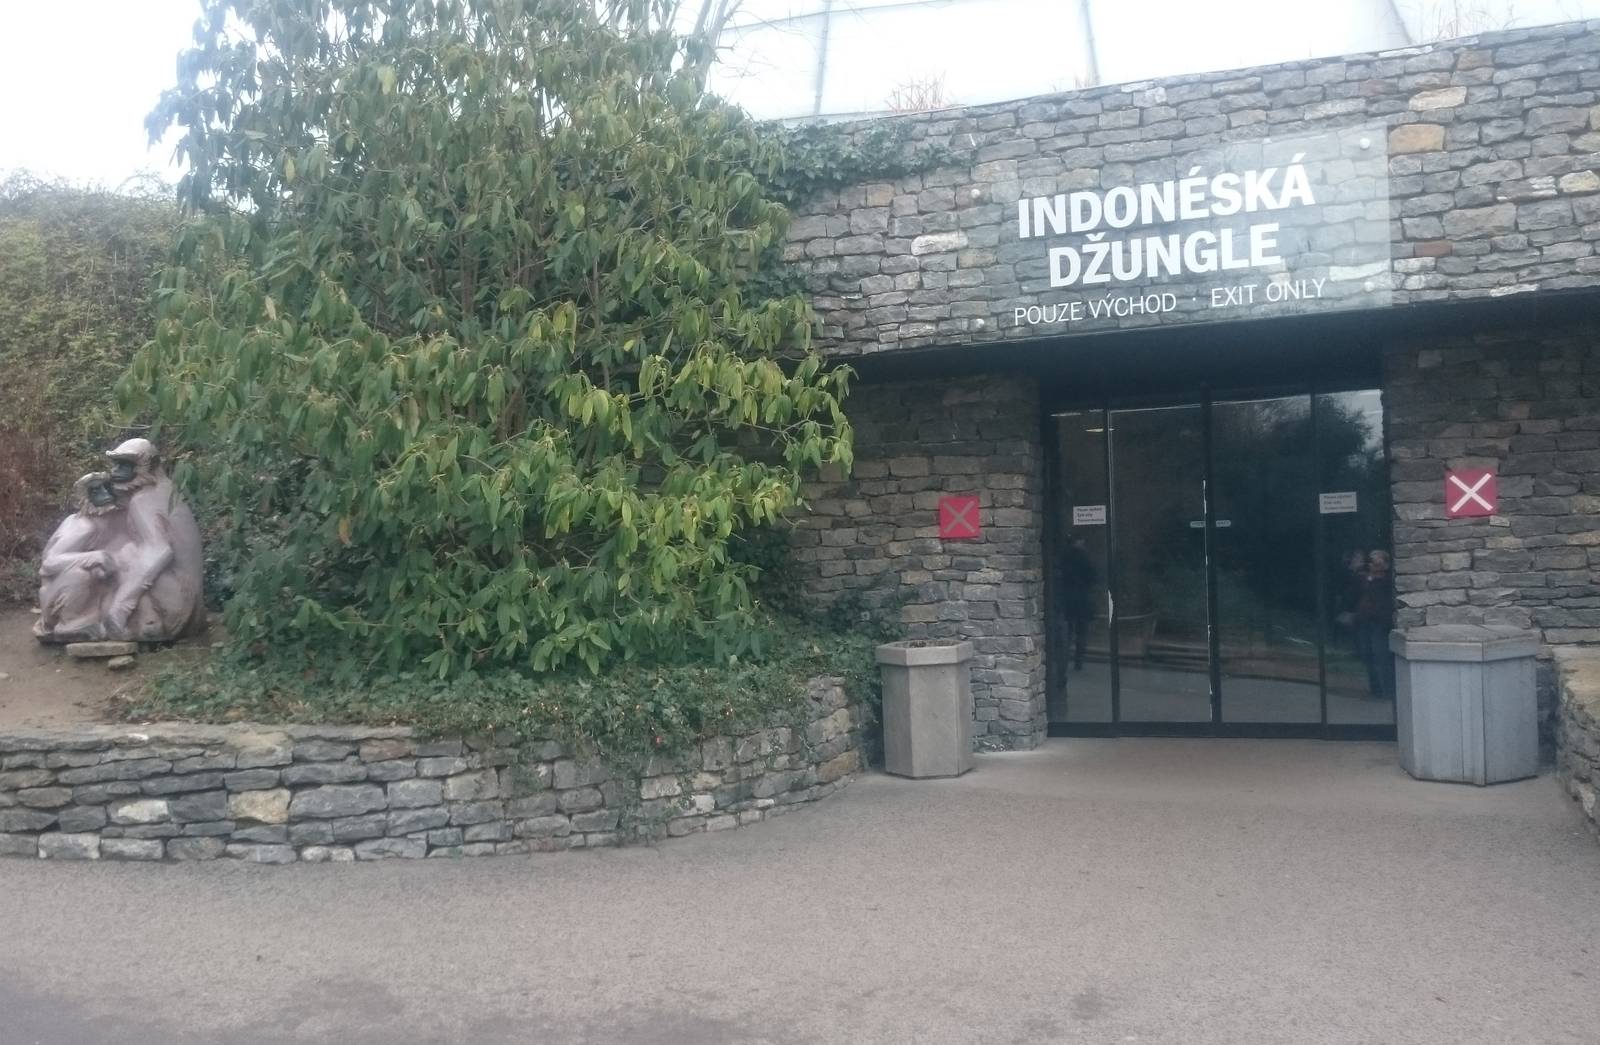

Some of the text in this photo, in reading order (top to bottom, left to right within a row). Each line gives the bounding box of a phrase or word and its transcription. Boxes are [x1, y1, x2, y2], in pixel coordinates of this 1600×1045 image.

[1018, 152, 1316, 239] INDONÉSKÁ
[1049, 222, 1282, 288] DŽUNGLE
[1014, 277, 1328, 326] POUZE VÝCHOD EXIT ONLY
